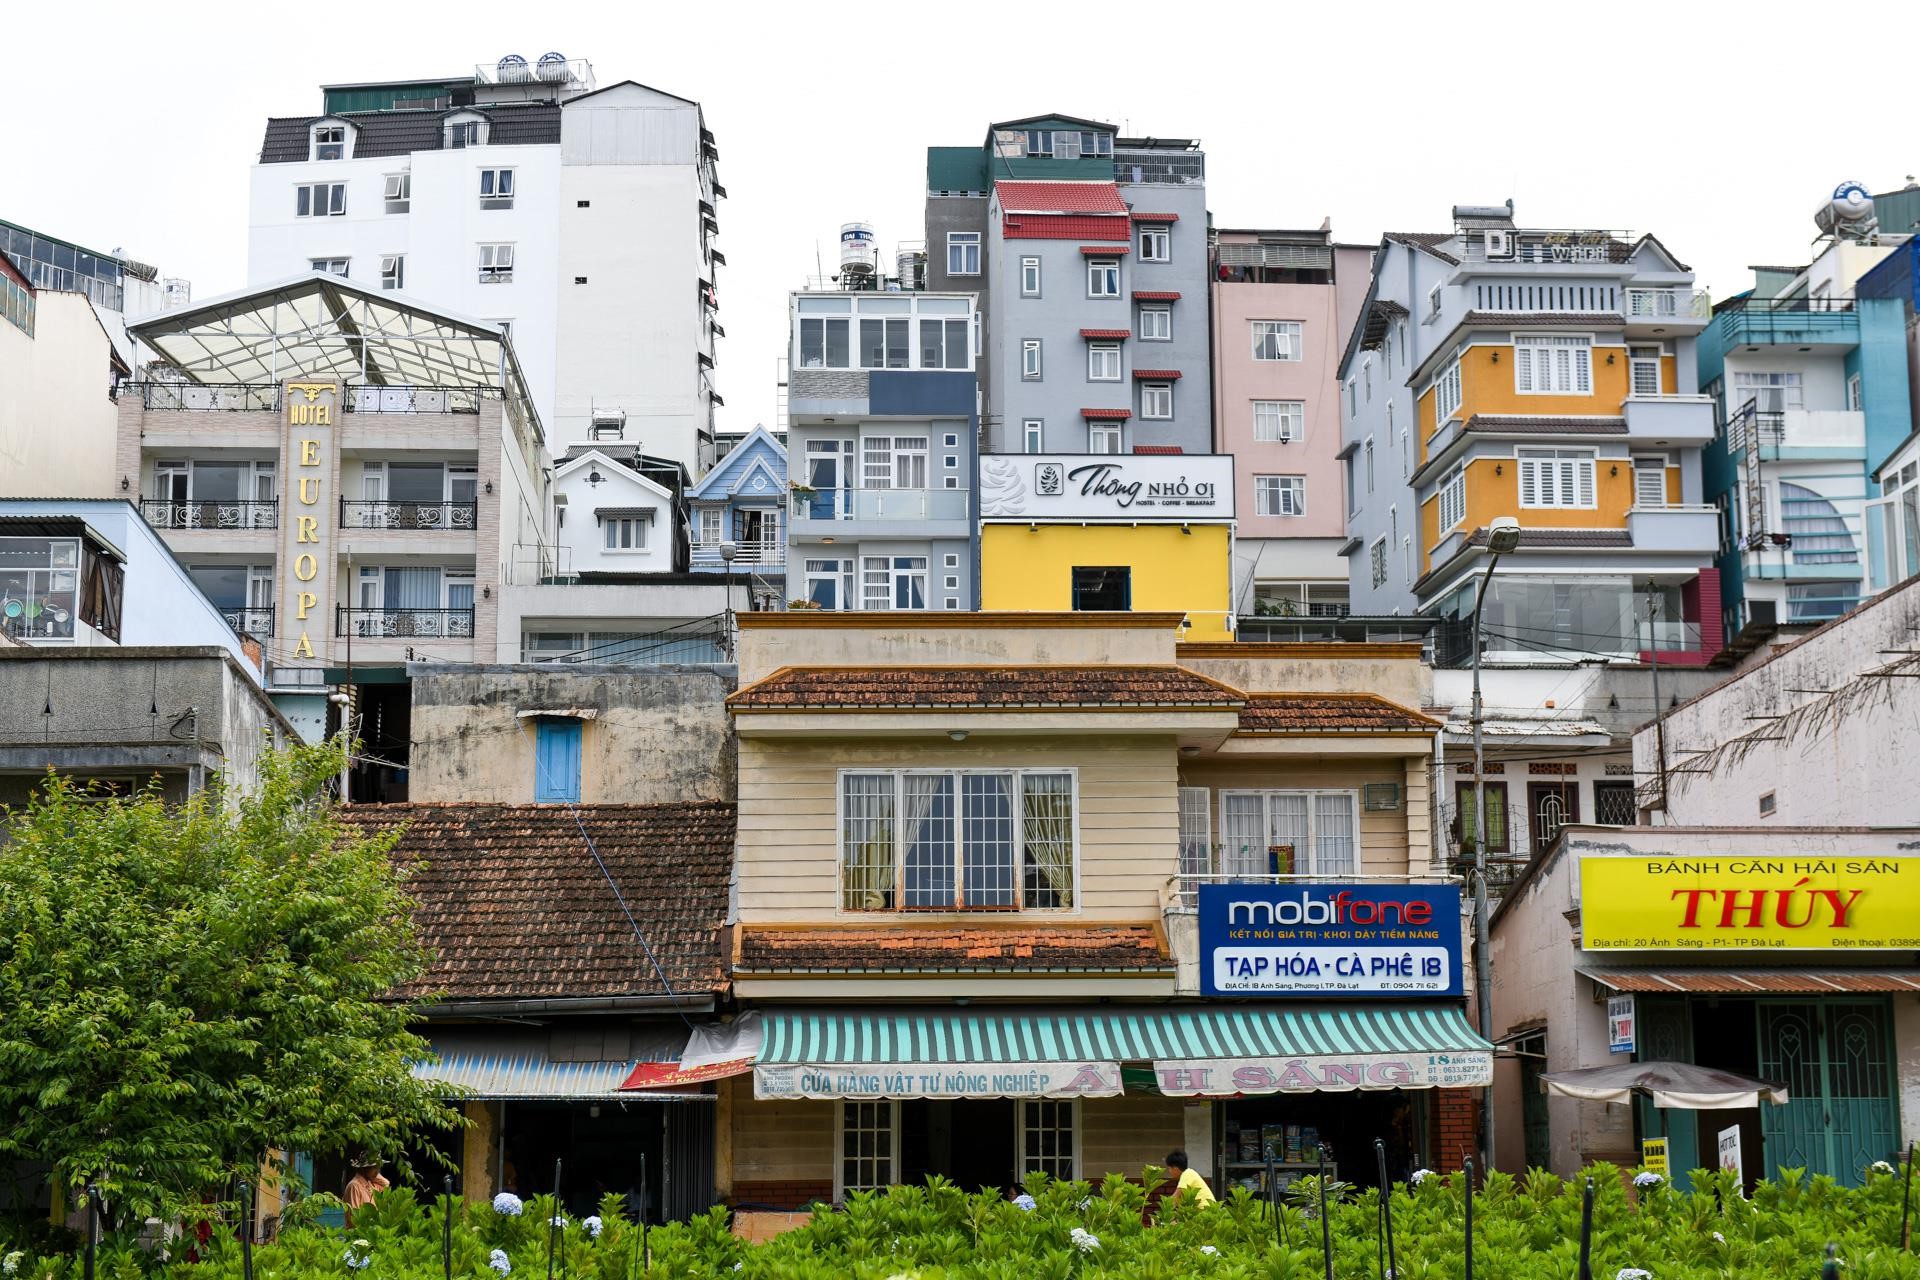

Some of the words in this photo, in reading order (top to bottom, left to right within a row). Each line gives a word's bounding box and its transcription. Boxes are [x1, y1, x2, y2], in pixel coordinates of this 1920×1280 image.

[1484, 230, 1518, 262] DJ
[291, 404, 331, 425] HOTEL
[1068, 463, 1142, 508] Thông
[1148, 476, 1189, 496] NHỎ
[293, 440, 321, 659] EUROPA
[1648, 860, 1719, 874] BÁNH
[1729, 860, 1785, 874] CĂN
[1794, 860, 1836, 874] HẢI
[1846, 860, 1899, 874] SẢN
[1229, 891, 1433, 925] mobifone
[1671, 877, 1863, 929] THÚY
[1593, 938, 1611, 948] Địa
[1634, 938, 1647, 947] 20
[1677, 938, 1703, 949] Sáng
[1734, 938, 1748, 947] TP
[1769, 938, 1785, 948] Lạt
[1832, 938, 1855, 948] Điện
[1225, 957, 1269, 979] TẠP
[1275, 952, 1321, 976] HÓA
[1336, 953, 1365, 976] CÀ
[1371, 952, 1413, 976] PHÊ
[1422, 957, 1442, 976] 18
[801, 1069, 832, 1093] CỬA
[837, 1071, 880, 1093] HÀNG
[885, 1070, 914, 1096] VẬT
[919, 1071, 942, 1093] TƯ
[945, 1070, 985, 1093] NÔNG
[993, 1069, 1050, 1095] NGHIỆP
[1231, 1059, 1412, 1089] SÁNG
